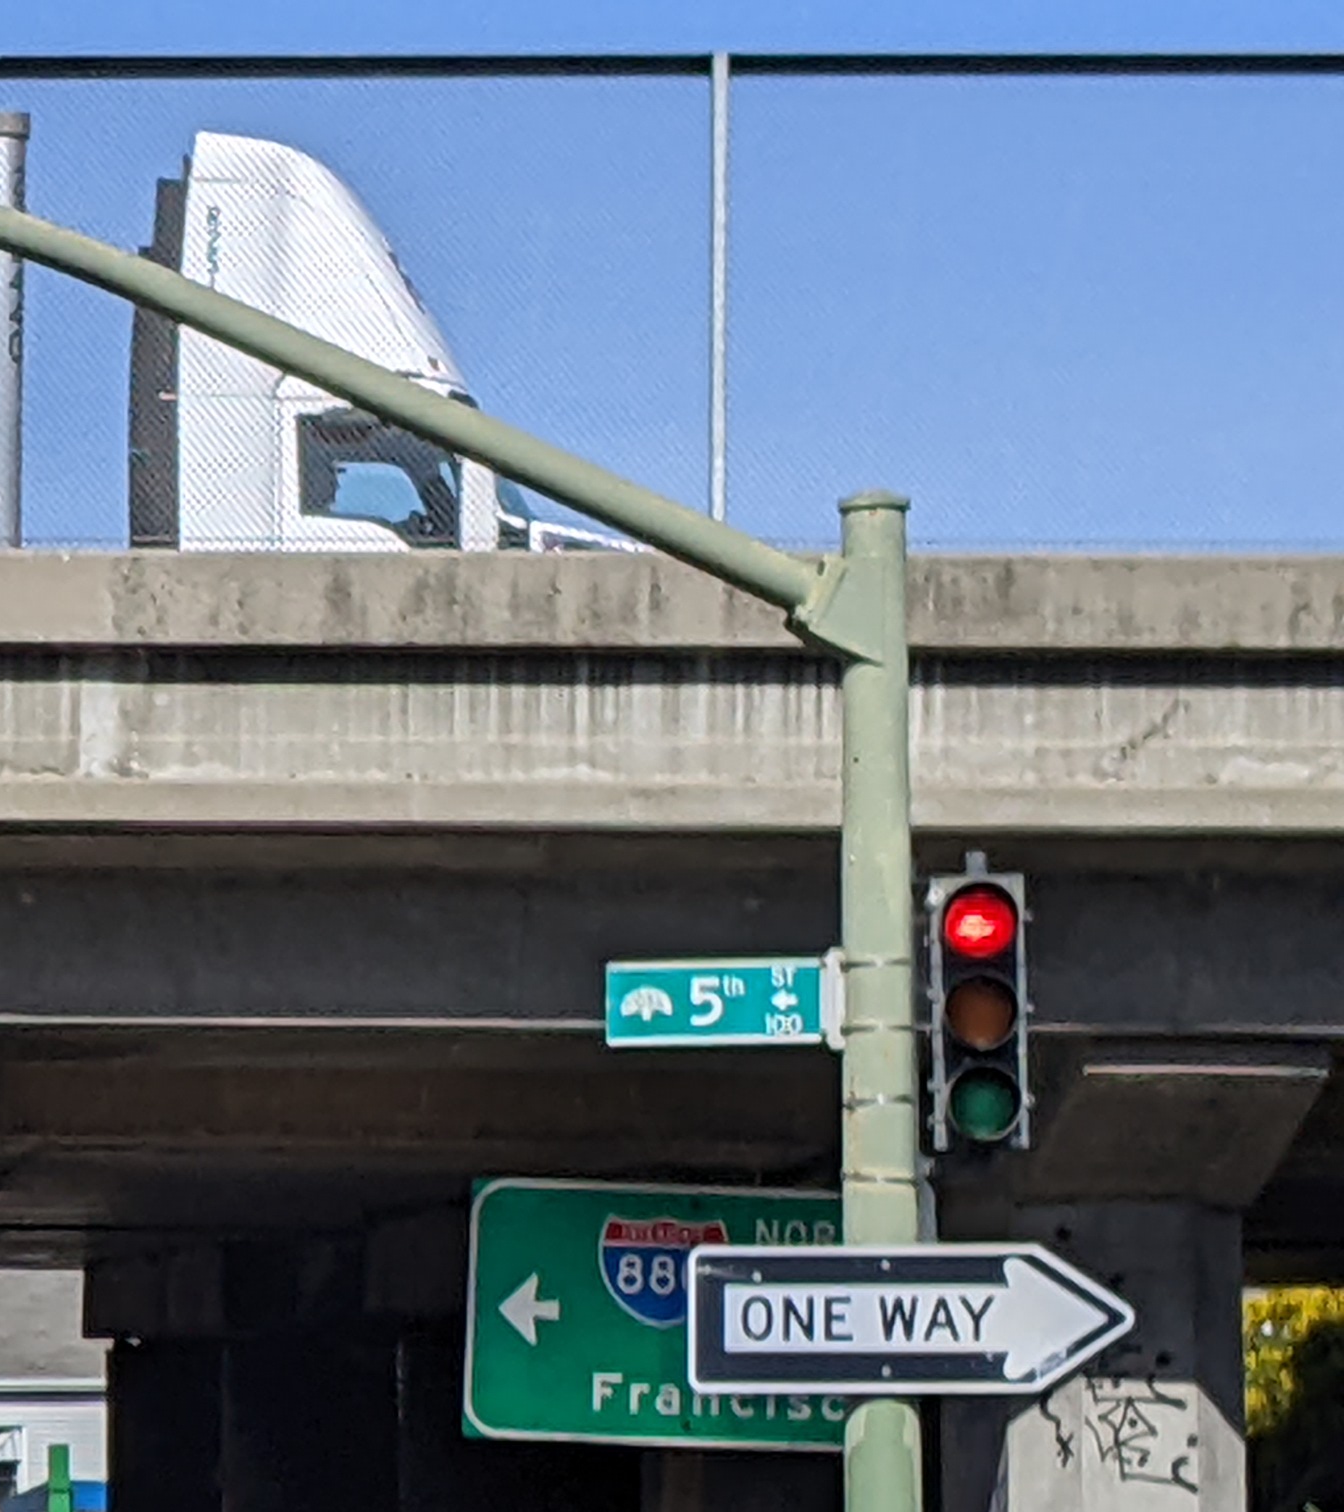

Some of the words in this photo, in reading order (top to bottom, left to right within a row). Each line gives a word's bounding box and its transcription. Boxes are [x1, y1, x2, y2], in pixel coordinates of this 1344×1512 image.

[689, 975, 746, 1027] 5th
[770, 966, 798, 988] ST
[755, 1218, 836, 1245] NOR
[616, 1253, 686, 1296] 88
[740, 1295, 852, 1343] ONE
[878, 1296, 995, 1342] WAY
[591, 1371, 846, 1422] Francisc
